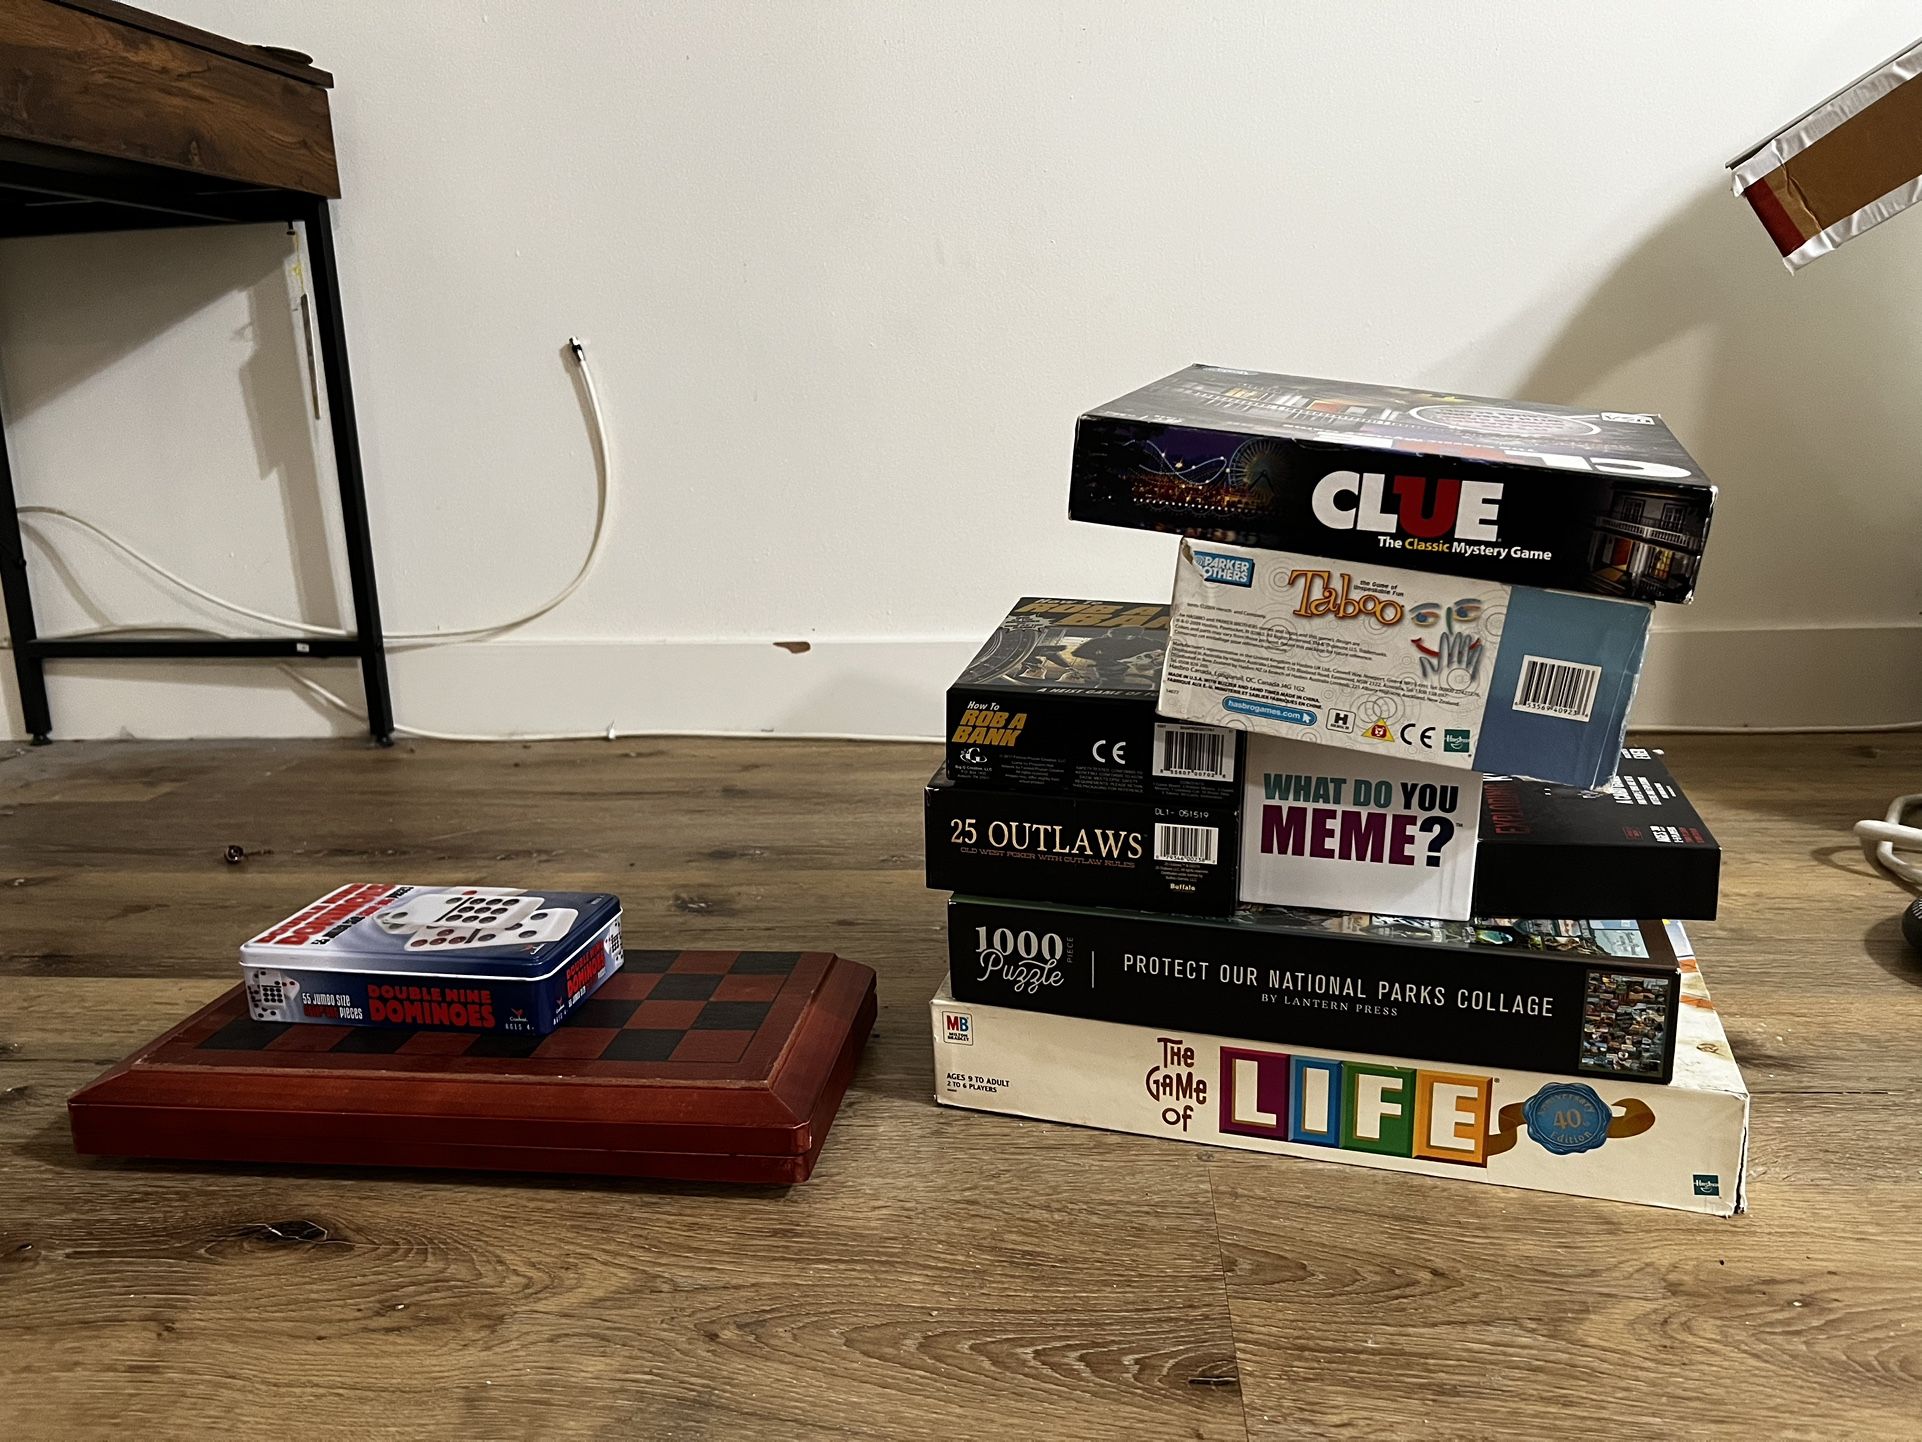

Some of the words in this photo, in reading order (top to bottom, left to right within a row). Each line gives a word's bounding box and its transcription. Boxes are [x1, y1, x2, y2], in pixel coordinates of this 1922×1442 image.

[1312, 470, 1504, 542] CLUE
[1378, 536, 1402, 548] The
[1405, 538, 1450, 552] Classic
[1451, 542, 1508, 559] Mystery
[1511, 547, 1552, 560] Game
[1203, 566, 1248, 582] OTHERS
[1204, 555, 1249, 572] PARKER
[1371, 581, 1389, 589] Game
[1288, 569, 1403, 625] Taboo
[1013, 602, 1125, 614] ROB
[967, 701, 988, 710] How
[990, 702, 1000, 710] To
[1228, 700, 1301, 721] hasbrogames.com
[960, 710, 1009, 728] ROB
[1007, 713, 1028, 730] A
[951, 725, 1022, 747] BANK
[1263, 773, 1346, 804] WHAT
[1353, 779, 1392, 808] DO
[1401, 782, 1459, 813] YOU
[1179, 809, 1209, 819] 051519
[950, 818, 977, 844] 25
[988, 821, 1143, 859] OUTLAWS
[1261, 804, 1455, 867] MEME?
[960, 846, 978, 854] OLD
[979, 848, 1005, 857] WEST
[1037, 853, 1062, 862] WITH
[1063, 855, 1101, 866] OUTLAW
[1104, 860, 1135, 869] RULES
[1170, 883, 1196, 891] Buffalo
[975, 926, 1063, 960] 1000
[1066, 936, 1074, 964] PIECE
[976, 948, 1064, 994] Puzzle
[367, 984, 441, 1001] DOUBLE
[445, 988, 491, 1003] NINE
[1123, 954, 1209, 980] PROTECT
[1220, 964, 1257, 986] OUR
[1269, 969, 1367, 998] NATIONAL
[1378, 981, 1445, 1006] PARKS
[1457, 988, 1554, 1017] COLLAGE
[302, 993, 311, 1004] 55
[1261, 993, 1277, 1004] BY
[1284, 994, 1348, 1011] LANTERN
[1355, 1003, 1399, 1017] PRESS
[369, 999, 496, 1028] DOMINOES
[947, 1015, 968, 1032] MB
[946, 1072, 965, 1081] AGES
[986, 1077, 1009, 1087] ADULT
[969, 1083, 997, 1093] PLAYERS
[1228, 1054, 1482, 1156] LIFE
[1551, 1131, 1592, 1144] Edition
